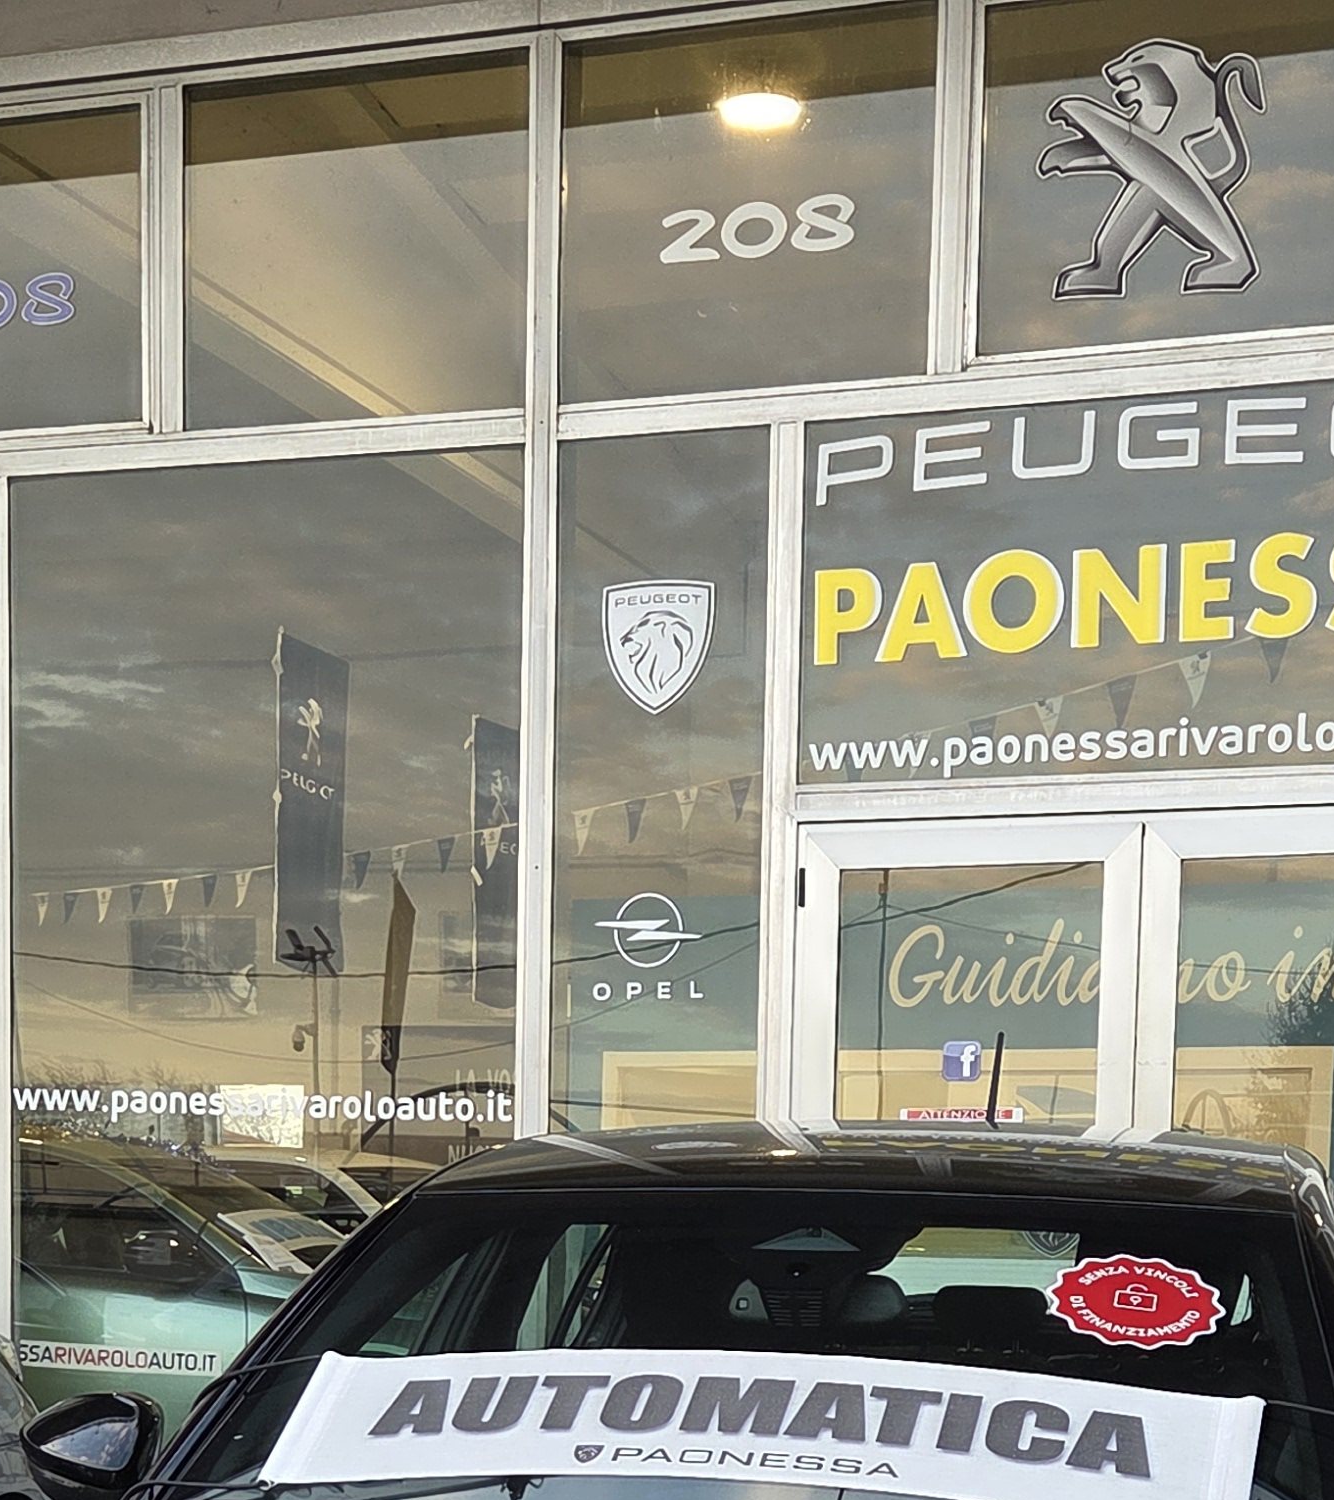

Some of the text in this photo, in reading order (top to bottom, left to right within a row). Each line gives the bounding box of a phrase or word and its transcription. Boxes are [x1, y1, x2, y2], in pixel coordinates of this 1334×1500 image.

[661, 194, 855, 265] 208
[614, 593, 703, 609] PEUGEOT
[592, 980, 705, 1002] OPEL
[13, 1087, 513, 1123] www.paonessarivaroloauto.it
[919, 1109, 1006, 1119] ATTENZIOE
[1078, 1265, 1200, 1299] SENZA VINCOLI
[1069, 1295, 1201, 1338] DI FINANZIAMENTO
[367, 1374, 1152, 1479] AUTOMATICA
[611, 1446, 899, 1479] PAONESSA
